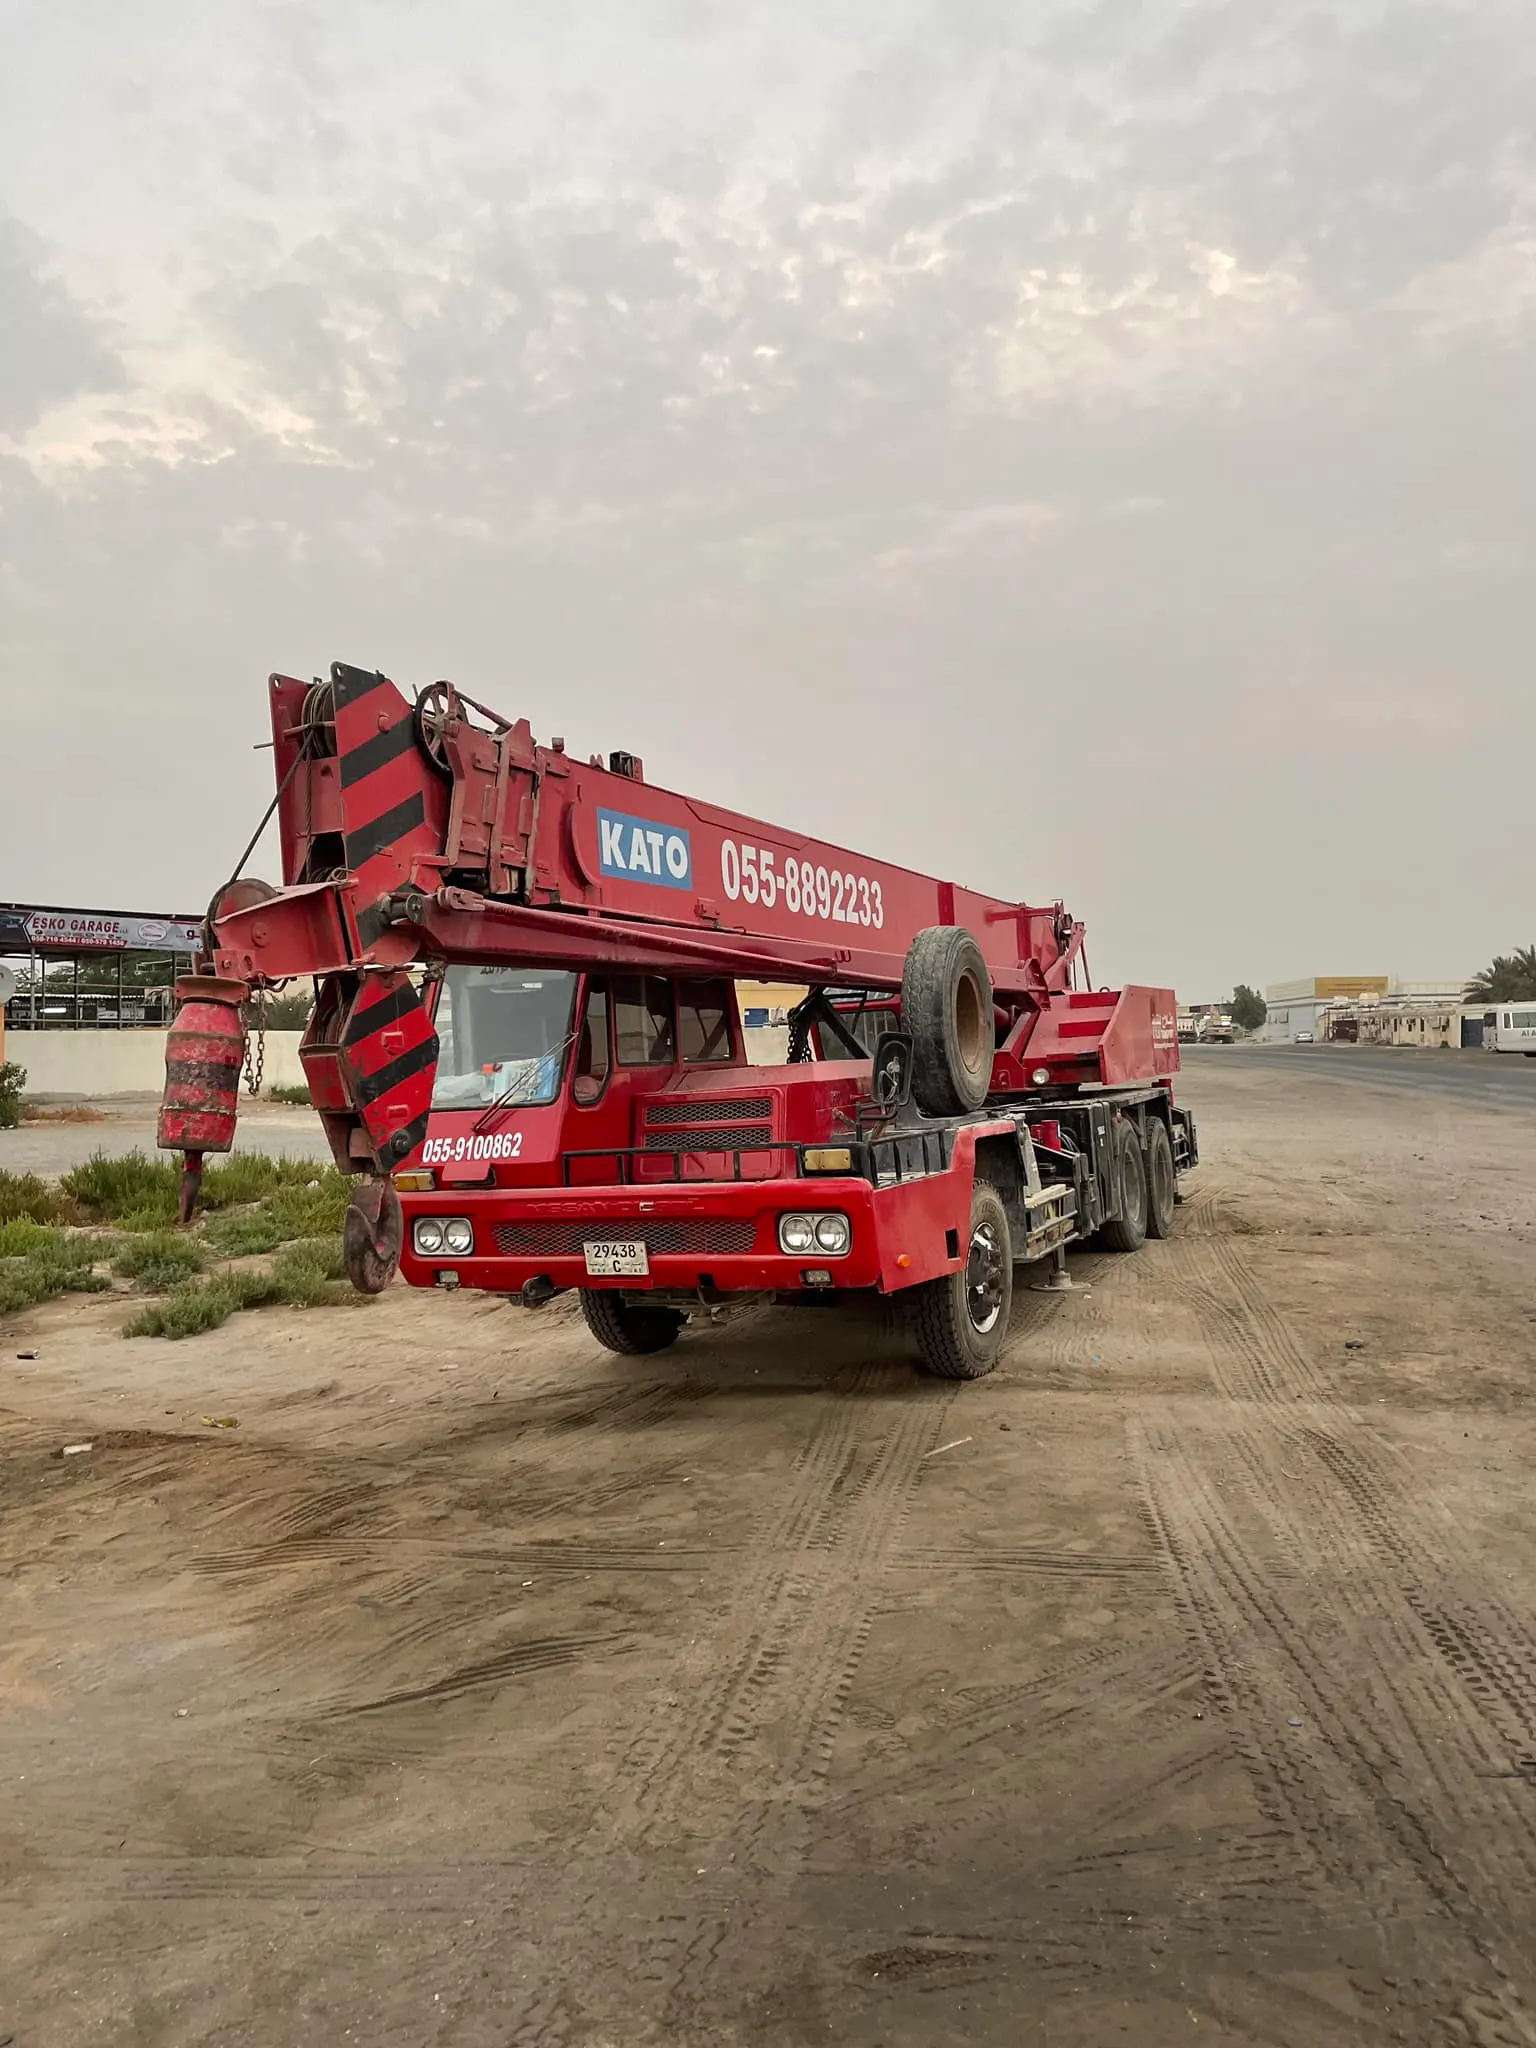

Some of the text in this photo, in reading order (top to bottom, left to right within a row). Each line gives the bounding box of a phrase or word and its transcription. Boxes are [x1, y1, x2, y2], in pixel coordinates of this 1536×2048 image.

[600, 818, 689, 880] KATO
[721, 838, 884, 929] 055-8892233
[32, 917, 65, 930] ESKO
[70, 919, 120, 933] GARAGE
[422, 1132, 523, 1163] 055-9100862
[593, 1244, 637, 1258] 29438
[612, 1259, 621, 1273] C
